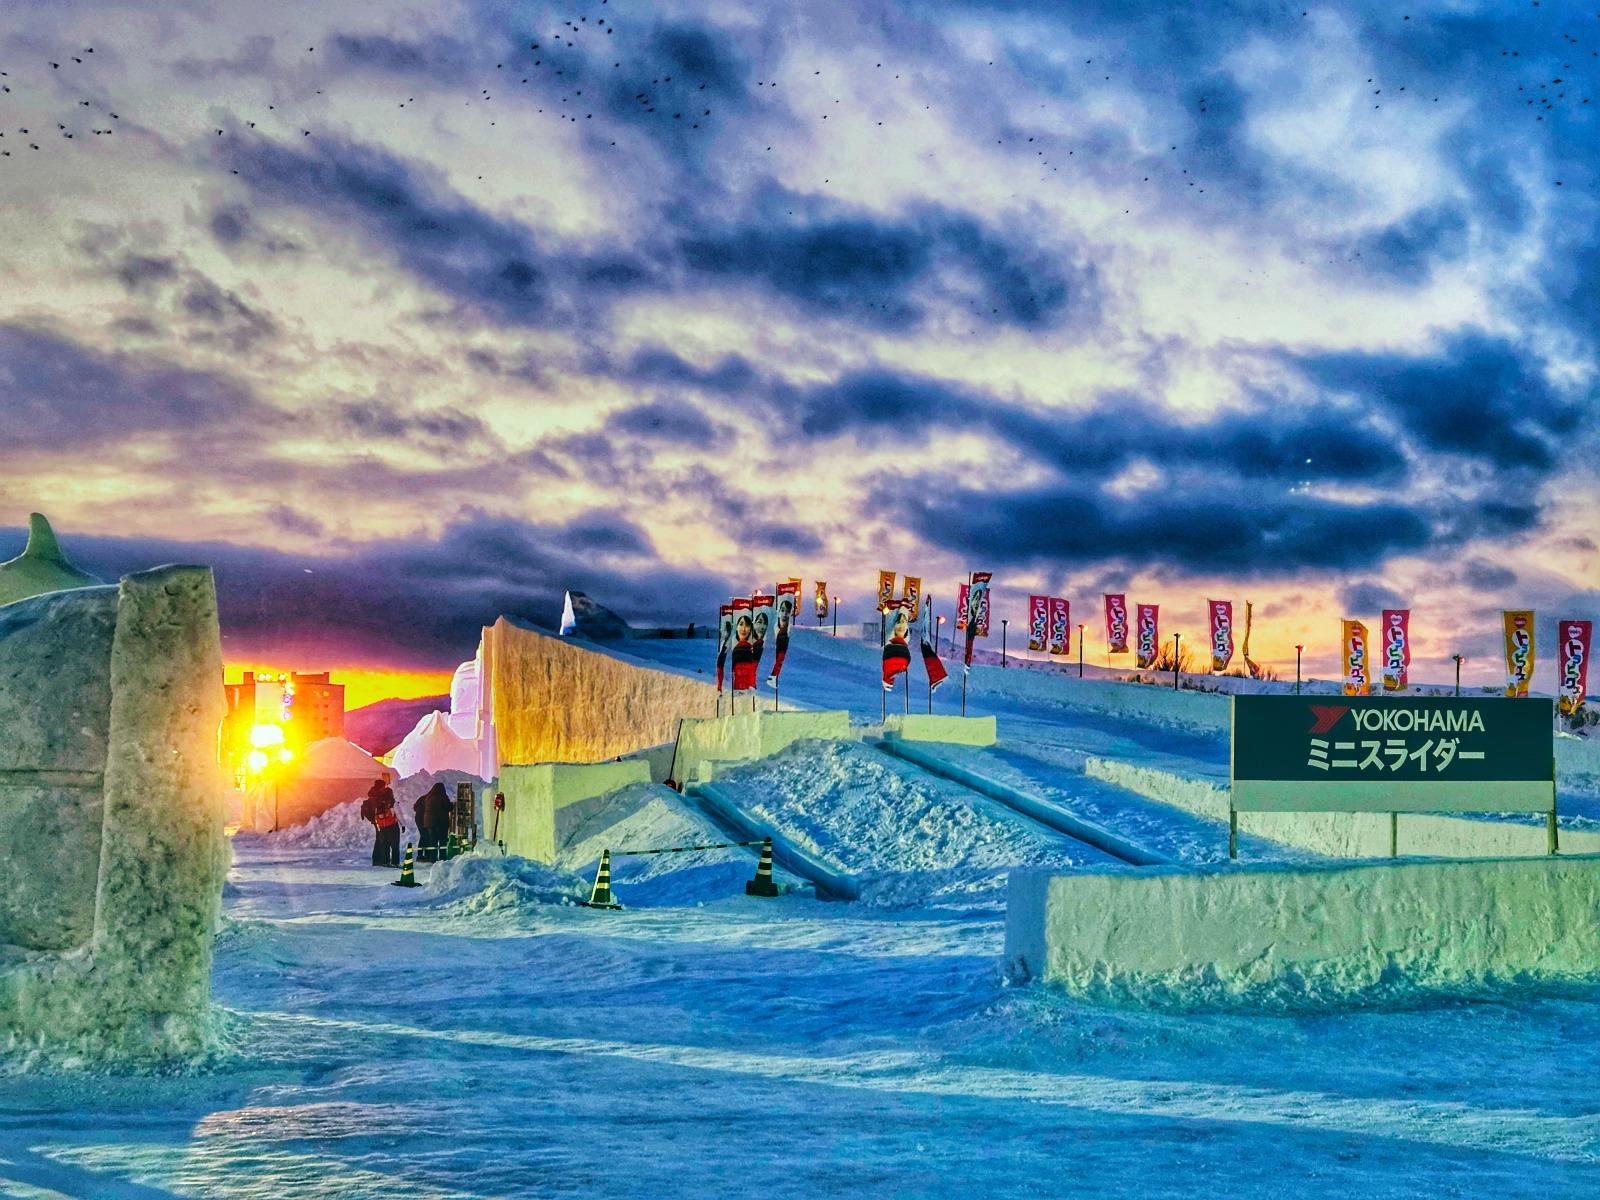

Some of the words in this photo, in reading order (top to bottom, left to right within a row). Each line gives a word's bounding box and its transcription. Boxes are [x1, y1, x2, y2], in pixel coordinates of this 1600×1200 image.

[1351, 709, 1486, 732] YOKOHAMA
[1307, 738, 1485, 772] ミニスライダー
